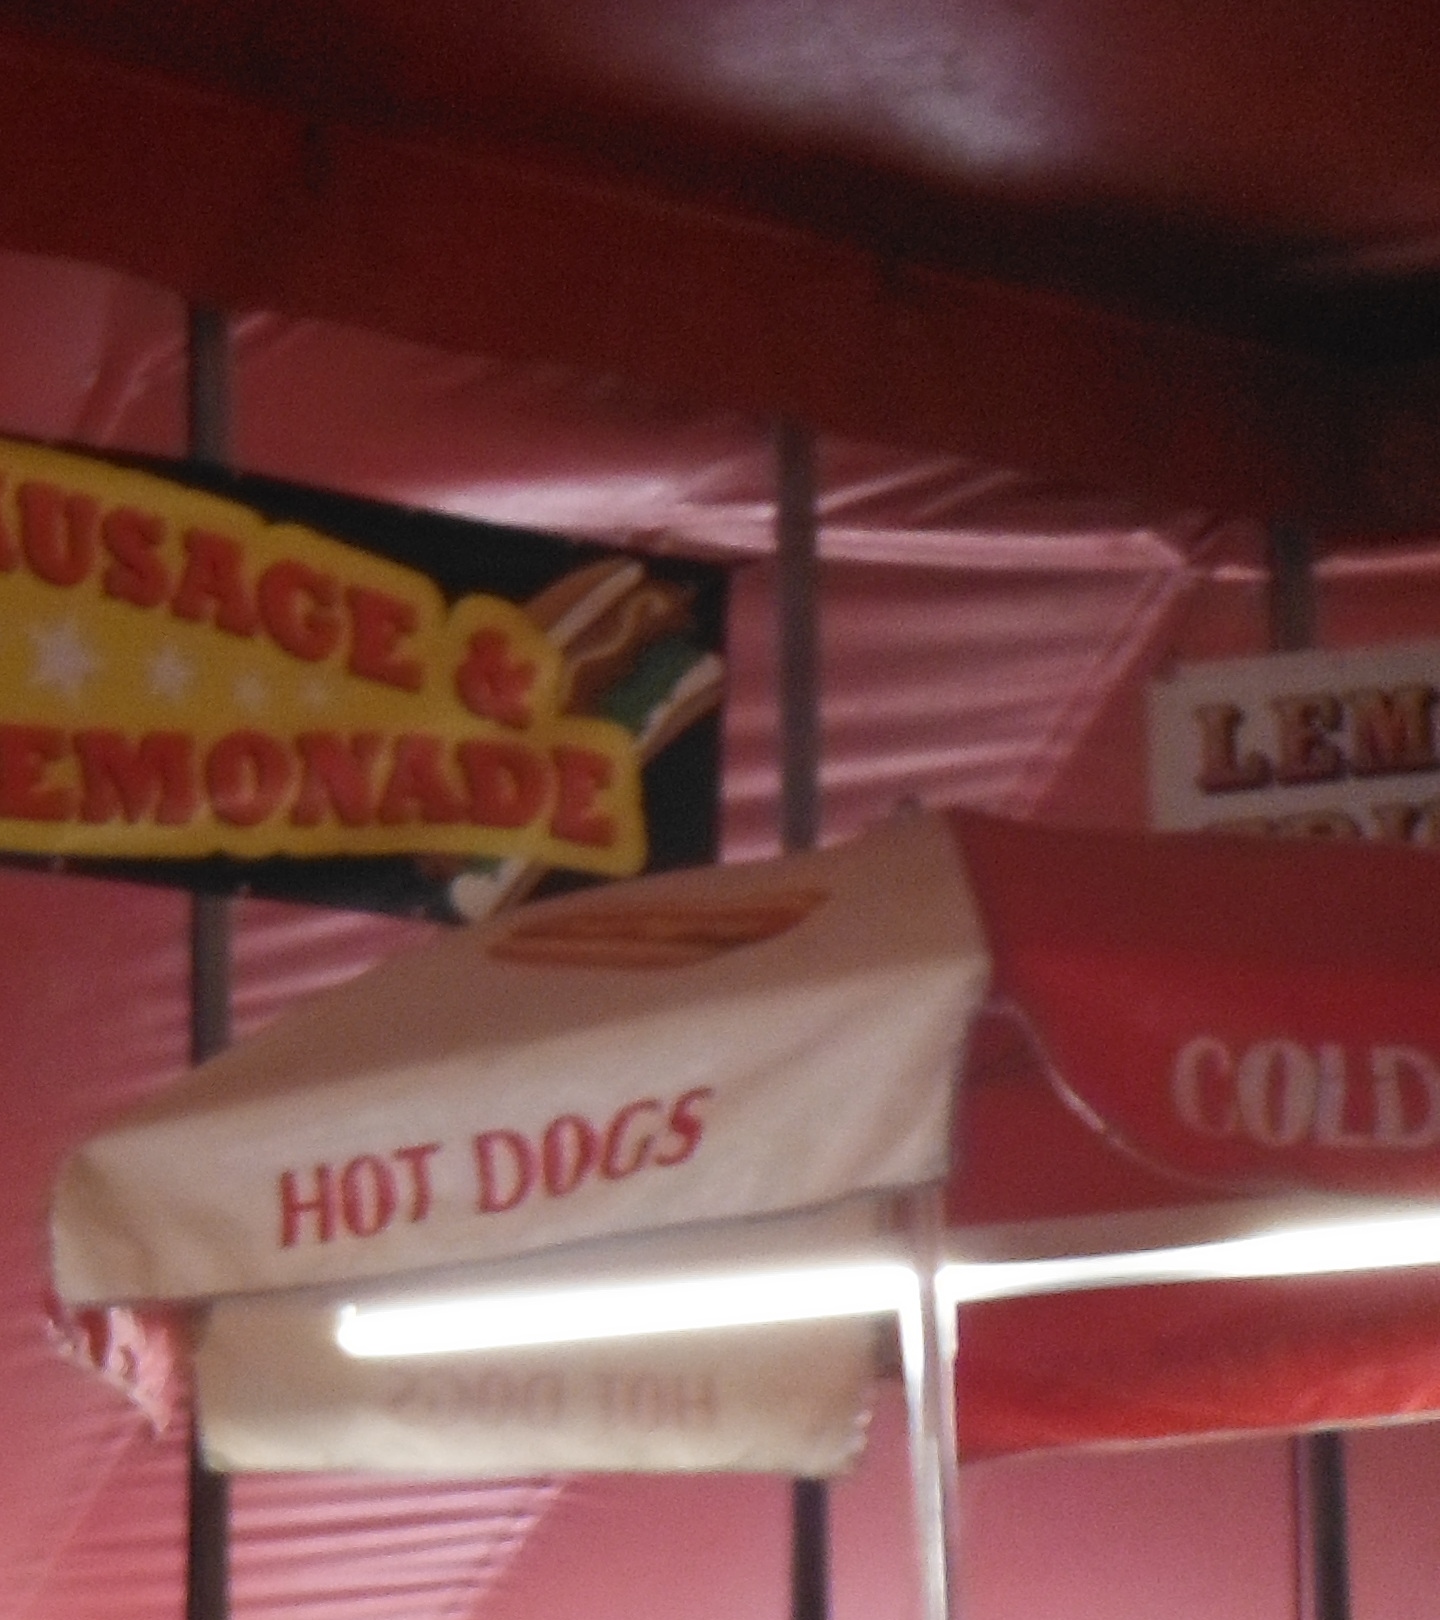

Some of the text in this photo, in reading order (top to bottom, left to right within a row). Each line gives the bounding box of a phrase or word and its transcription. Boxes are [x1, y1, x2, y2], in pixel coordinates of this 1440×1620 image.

[455, 627, 534, 729] &
[1174, 1036, 1440, 1149] COLD
[278, 1086, 714, 1249] HOT DOGS
